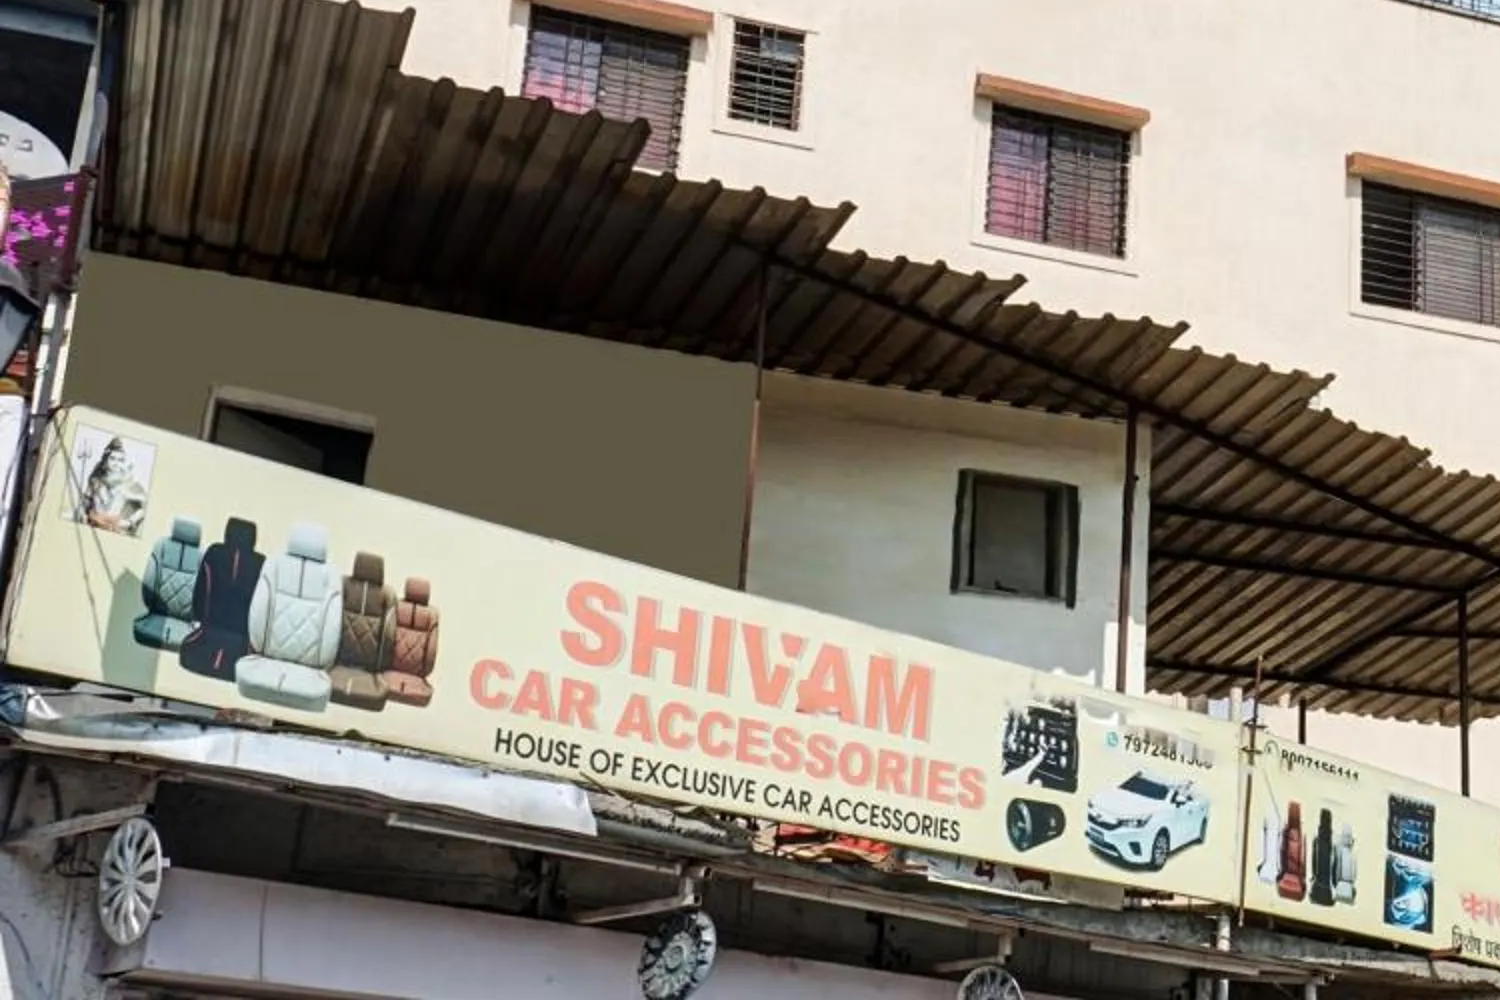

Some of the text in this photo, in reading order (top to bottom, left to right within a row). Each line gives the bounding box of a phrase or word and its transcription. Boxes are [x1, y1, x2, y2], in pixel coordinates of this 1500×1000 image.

[469, 658, 987, 811] CAR ACCESSORIES
[560, 580, 932, 742] SHIVAM
[494, 727, 960, 843] HOUSE OF EXCLUSIVE CAR ACCESSORIES
